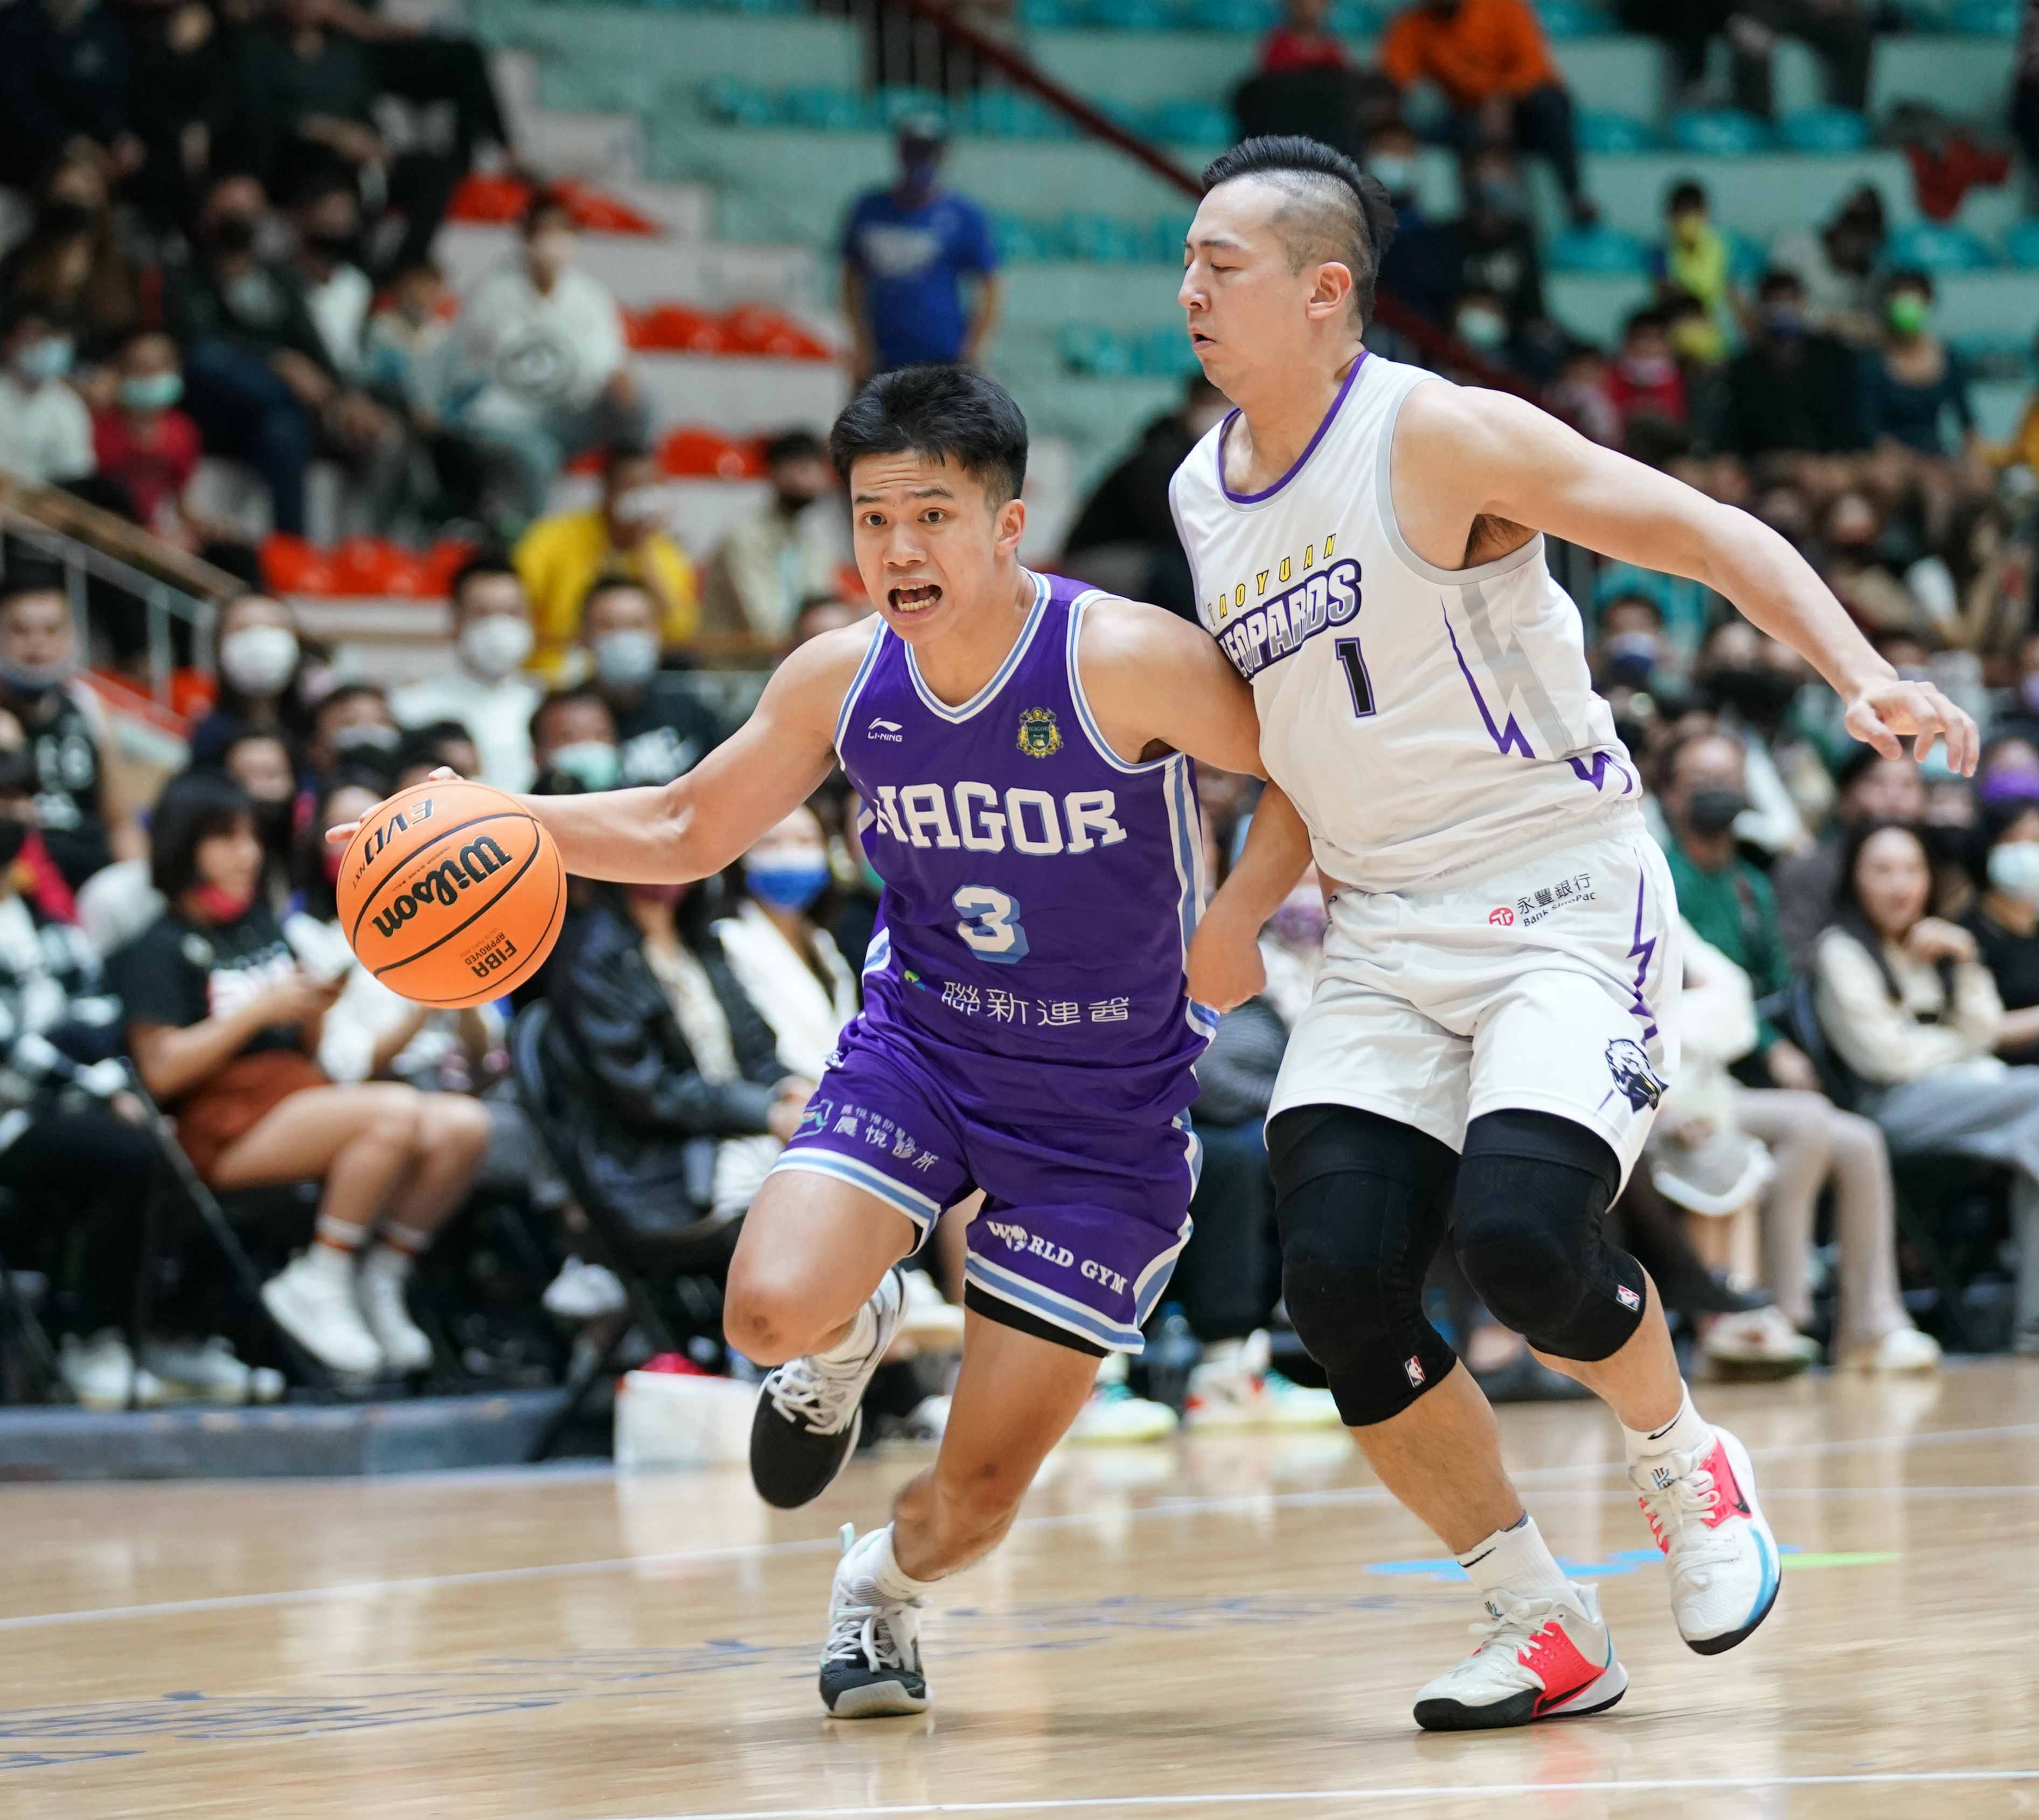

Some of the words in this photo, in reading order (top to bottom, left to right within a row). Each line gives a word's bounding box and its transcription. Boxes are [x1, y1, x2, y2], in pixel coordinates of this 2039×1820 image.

[1335, 637, 1377, 718] 1
[371, 834, 513, 937] Wilson
[1517, 873, 1591, 915] 永豐銀行
[952, 884, 1030, 964] 3
[1523, 909, 1549, 927] Bank
[464, 931, 505, 965] APPROVED
[471, 939, 517, 978] FIBA
[1080, 1259, 1128, 1296] GYM
